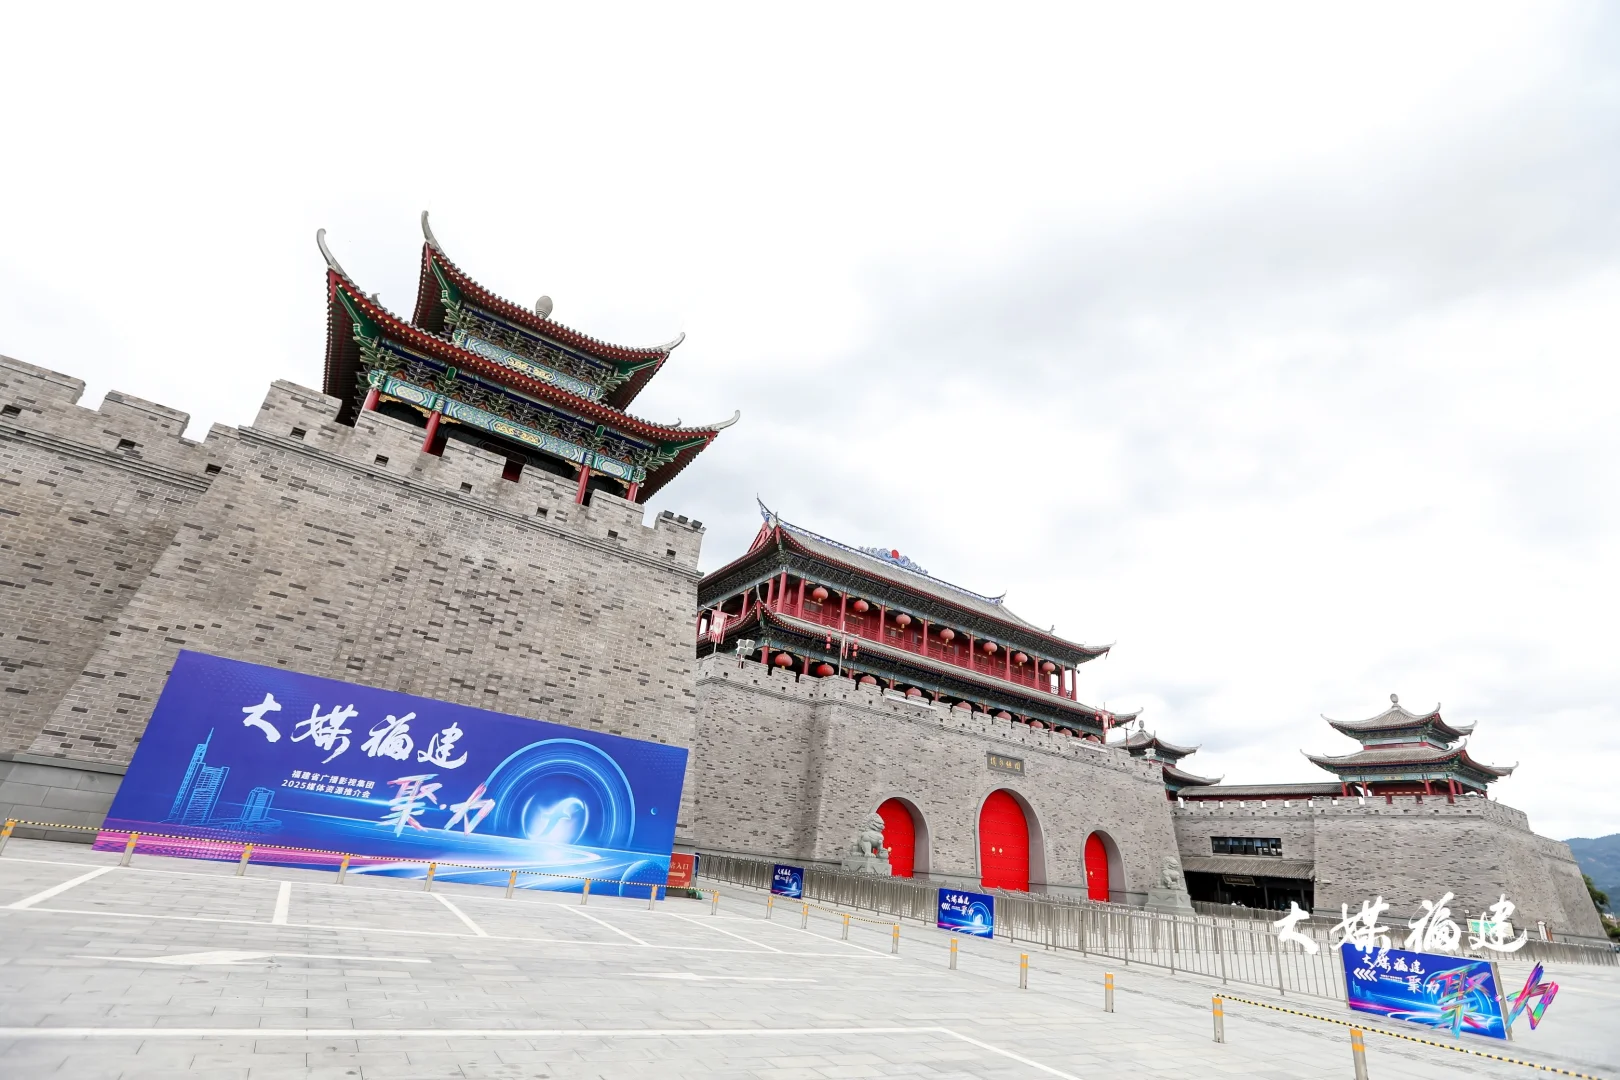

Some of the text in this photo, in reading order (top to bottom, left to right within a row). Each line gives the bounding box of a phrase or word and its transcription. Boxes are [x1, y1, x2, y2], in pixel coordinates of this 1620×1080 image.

[241, 692, 469, 770] 大媒福建
[281, 779, 371, 799] 2025媒体资源推介会
[291, 769, 376, 790] 福建省广播影视集团
